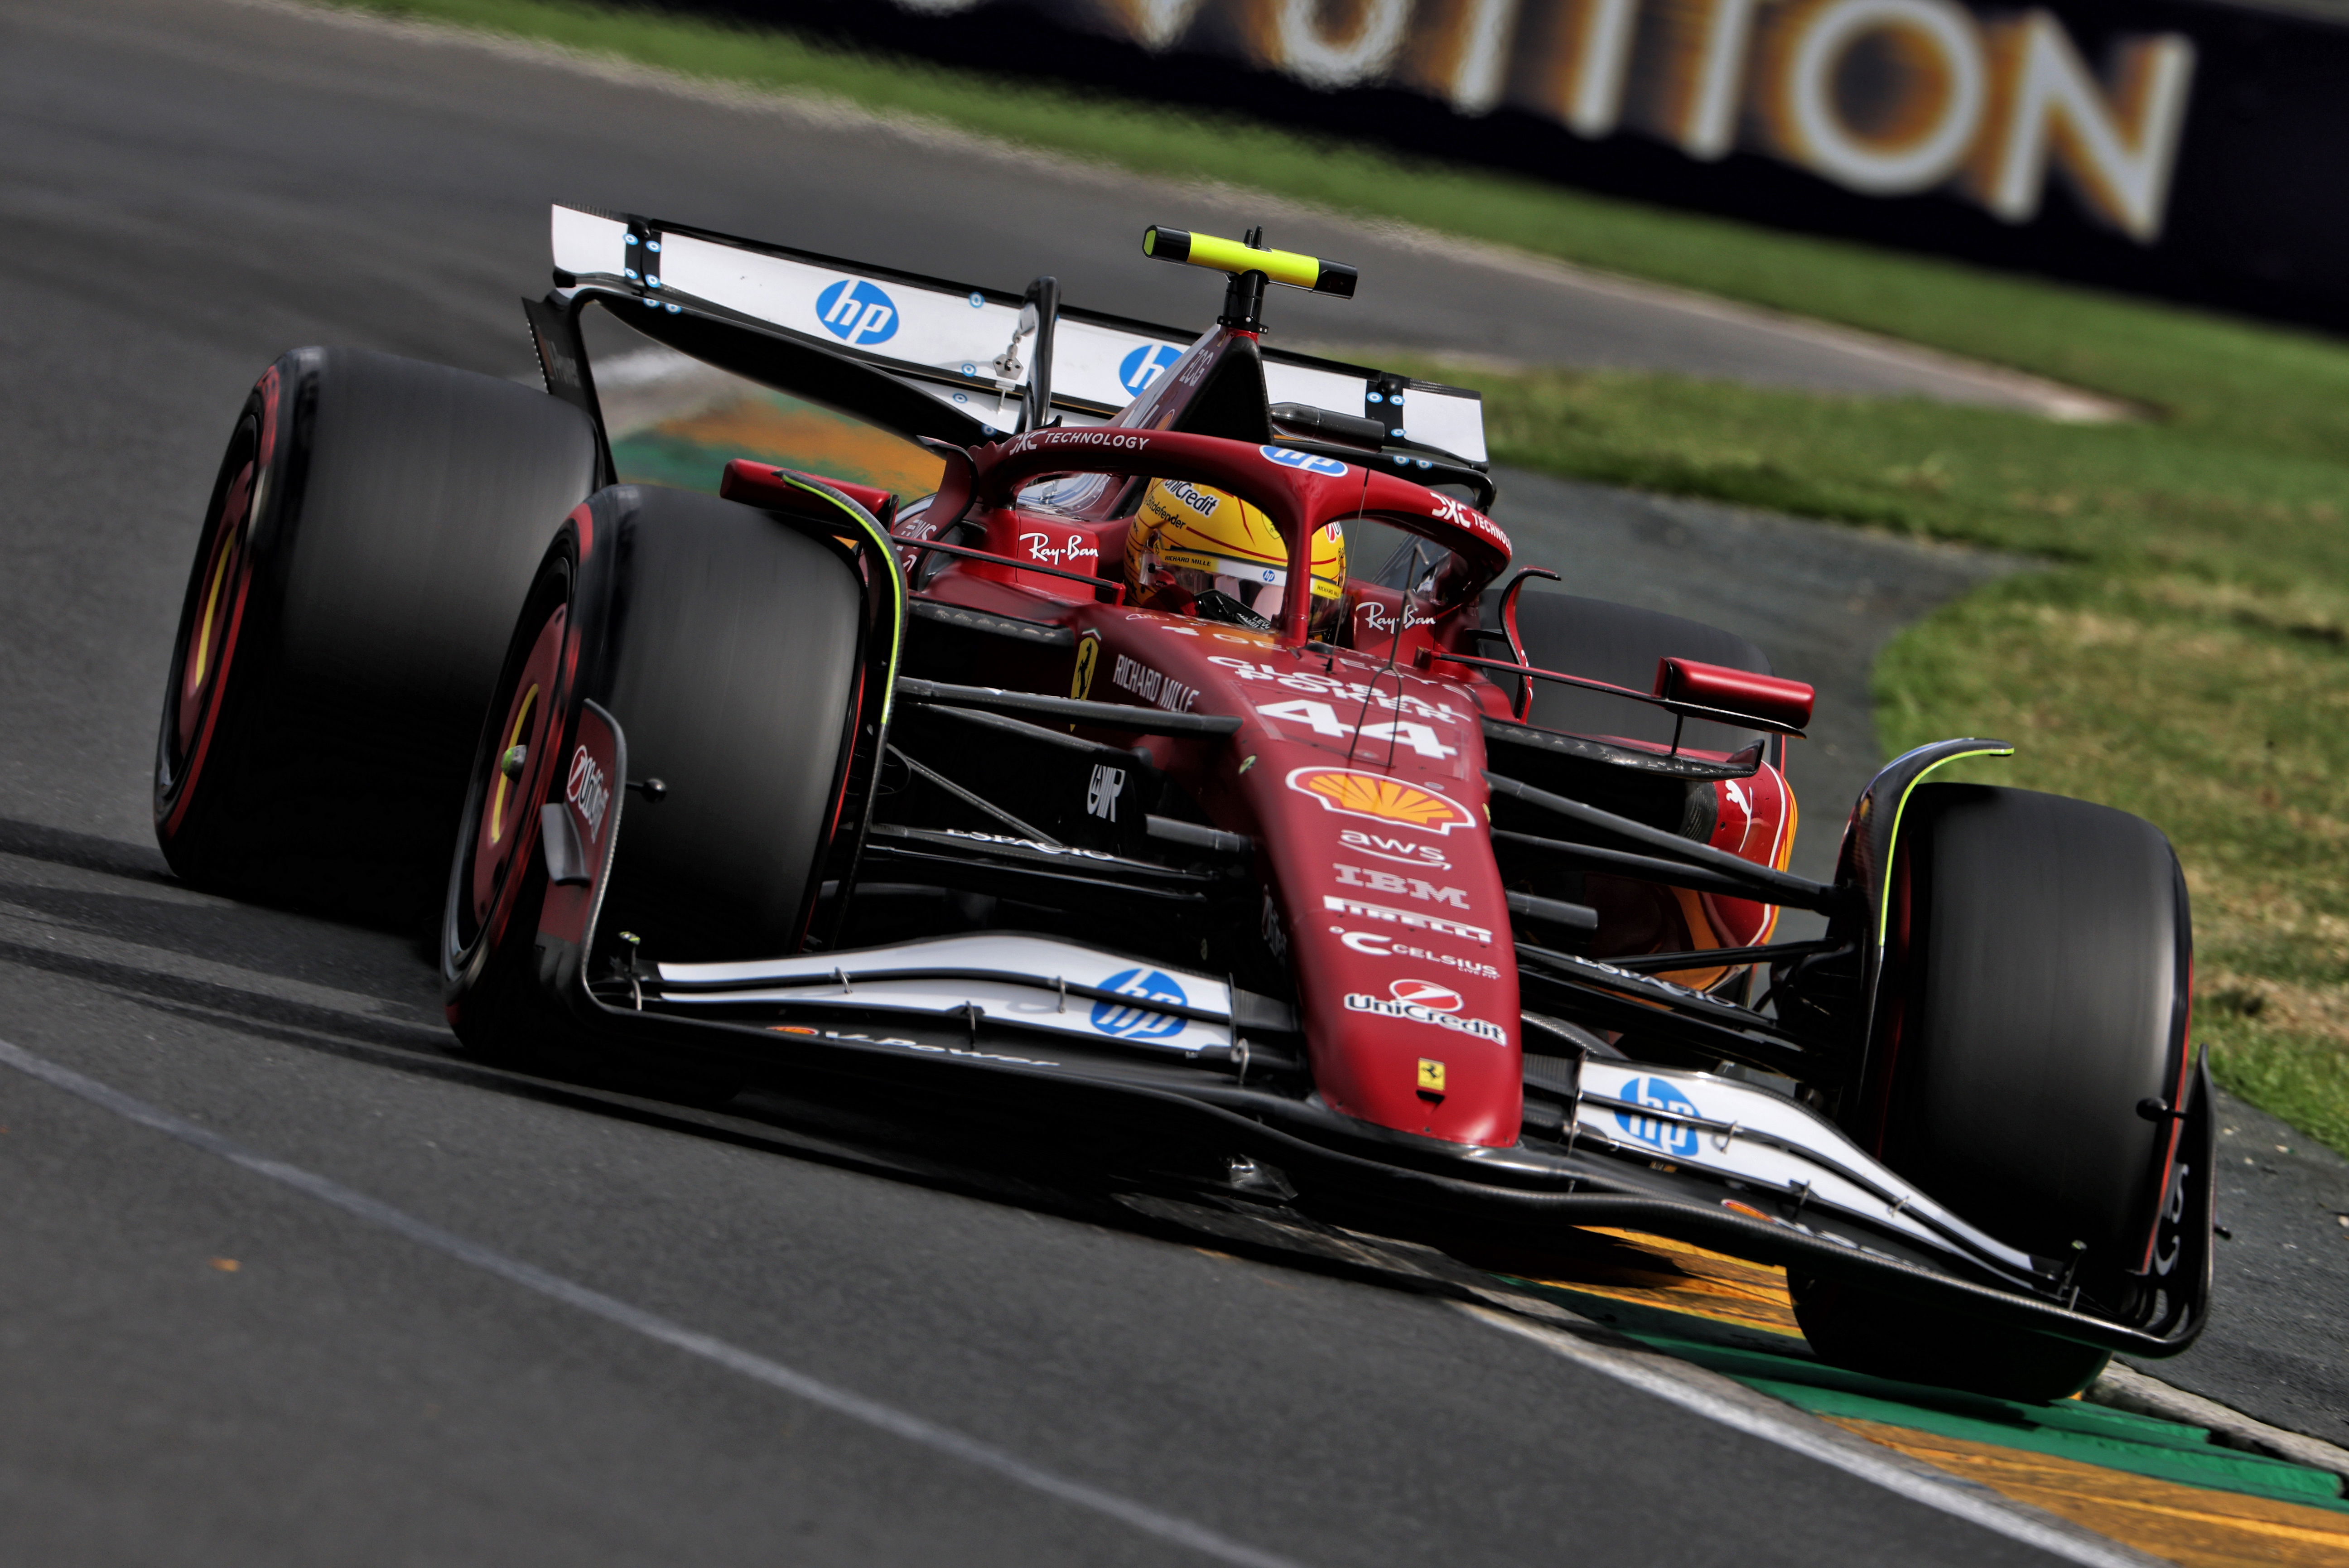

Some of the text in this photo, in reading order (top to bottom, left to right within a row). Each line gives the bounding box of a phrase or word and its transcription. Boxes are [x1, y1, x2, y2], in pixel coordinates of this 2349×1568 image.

[824, 280, 893, 344] hp
[1044, 433, 1150, 450] TECHNOLOGY
[1019, 532, 1099, 565] Ray-Ban
[1165, 555, 1211, 567] RICHARD MILLE
[1264, 570, 1275, 582] hp
[1355, 601, 1436, 634] Ray-Ban
[1113, 653, 1200, 713] RICHARD MILLE
[1207, 656, 1471, 722] GLOBAL
[1213, 633, 1472, 702] GEESYS
[1235, 668, 1456, 724] POKER
[1256, 699, 1458, 759] 44
[1340, 829, 1447, 861] aws
[1332, 862, 1471, 910] IBM
[1323, 894, 1492, 944] PIRELLI
[1391, 943, 1498, 976] CELSIUS
[1097, 968, 1183, 1037] hp
[1344, 992, 1507, 1047] UniCredit
[1630, 1077, 1695, 1153] hp
